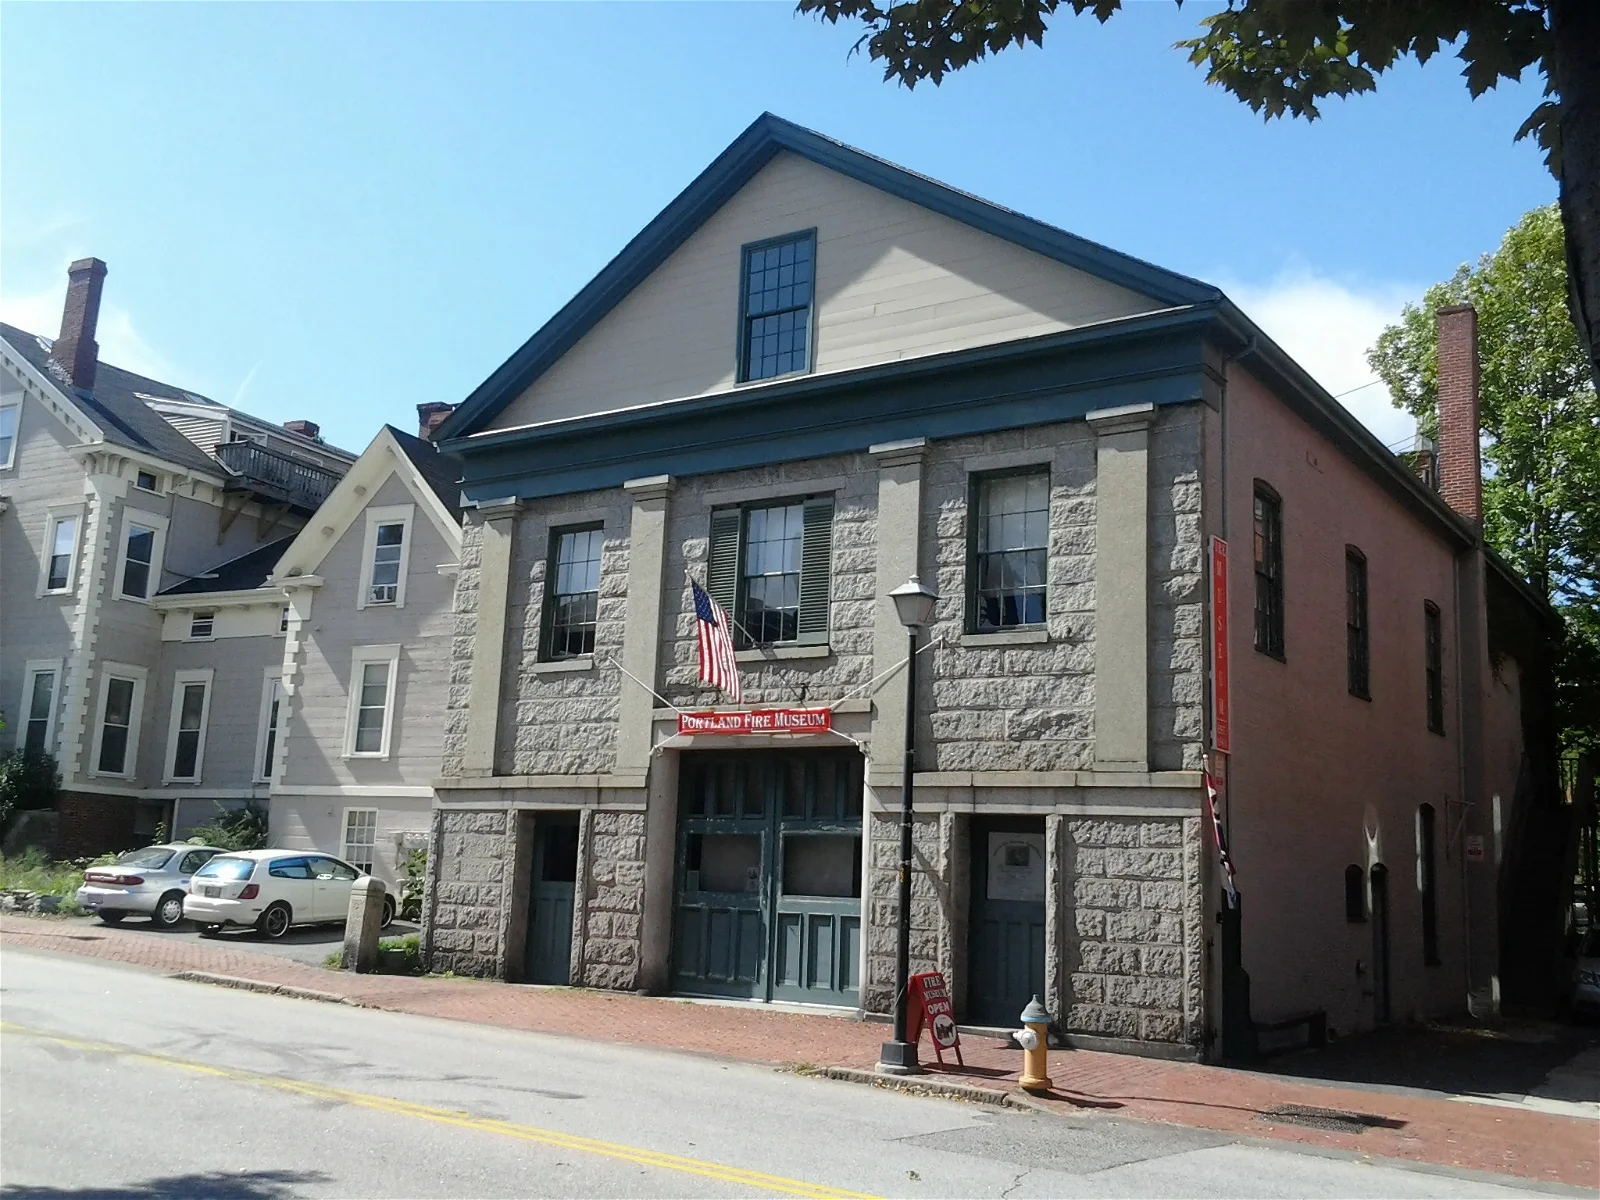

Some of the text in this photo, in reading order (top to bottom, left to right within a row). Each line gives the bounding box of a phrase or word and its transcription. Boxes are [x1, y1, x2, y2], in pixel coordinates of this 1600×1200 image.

[681, 711, 825, 729] PORTLAND FIRE MUSEUM
[923, 976, 941, 988] FIRE
[928, 1002, 950, 1014] OPEN
